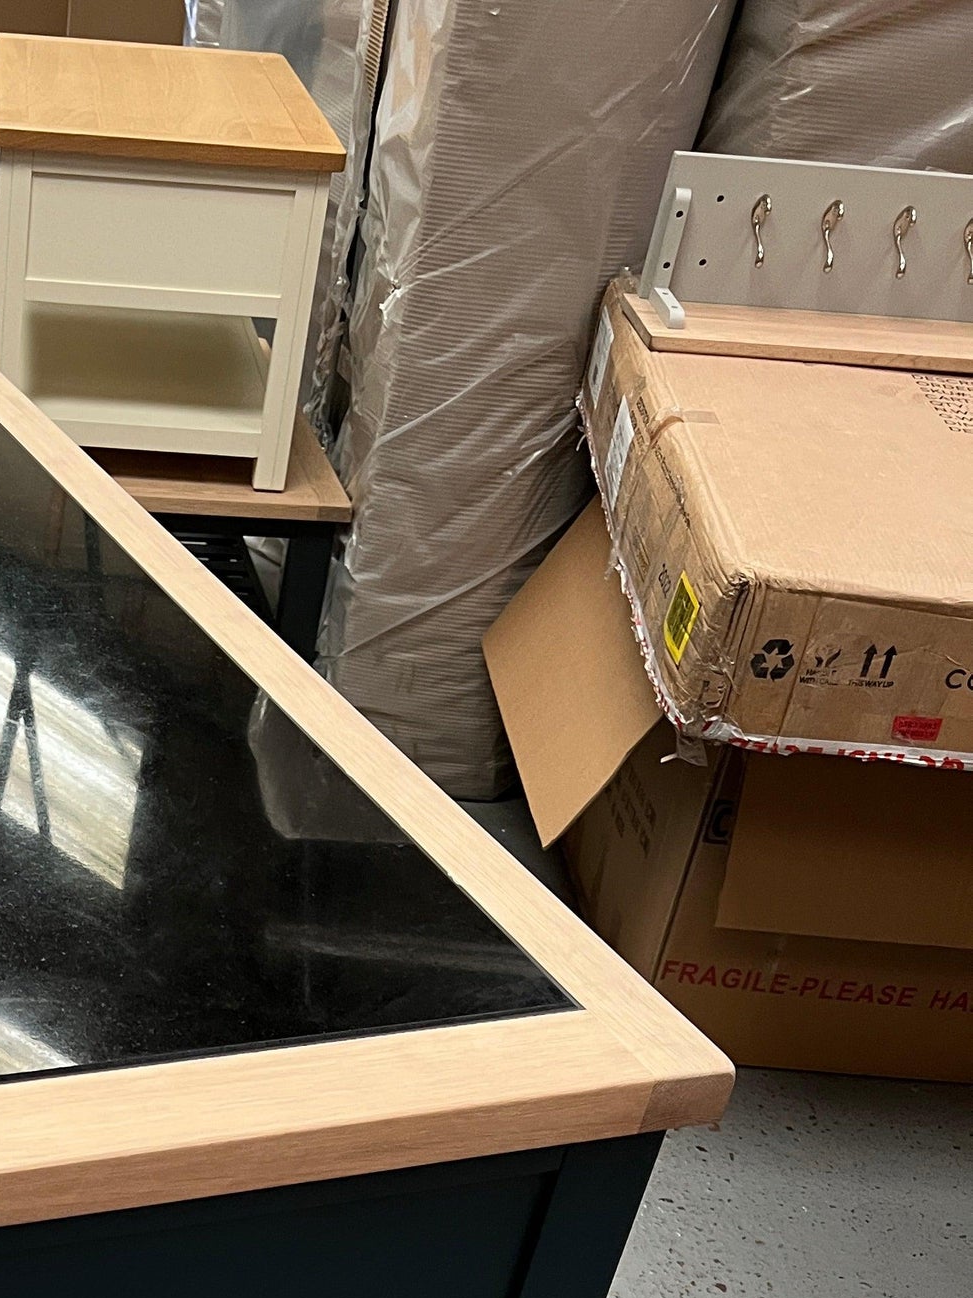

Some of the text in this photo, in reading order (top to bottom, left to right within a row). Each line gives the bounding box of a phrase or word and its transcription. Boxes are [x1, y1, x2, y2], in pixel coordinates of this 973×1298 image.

[911, 373, 973, 385] DESCR
[945, 668, 973, 691] C
[659, 959, 973, 1013] FRAGILE-PLEASE HA
